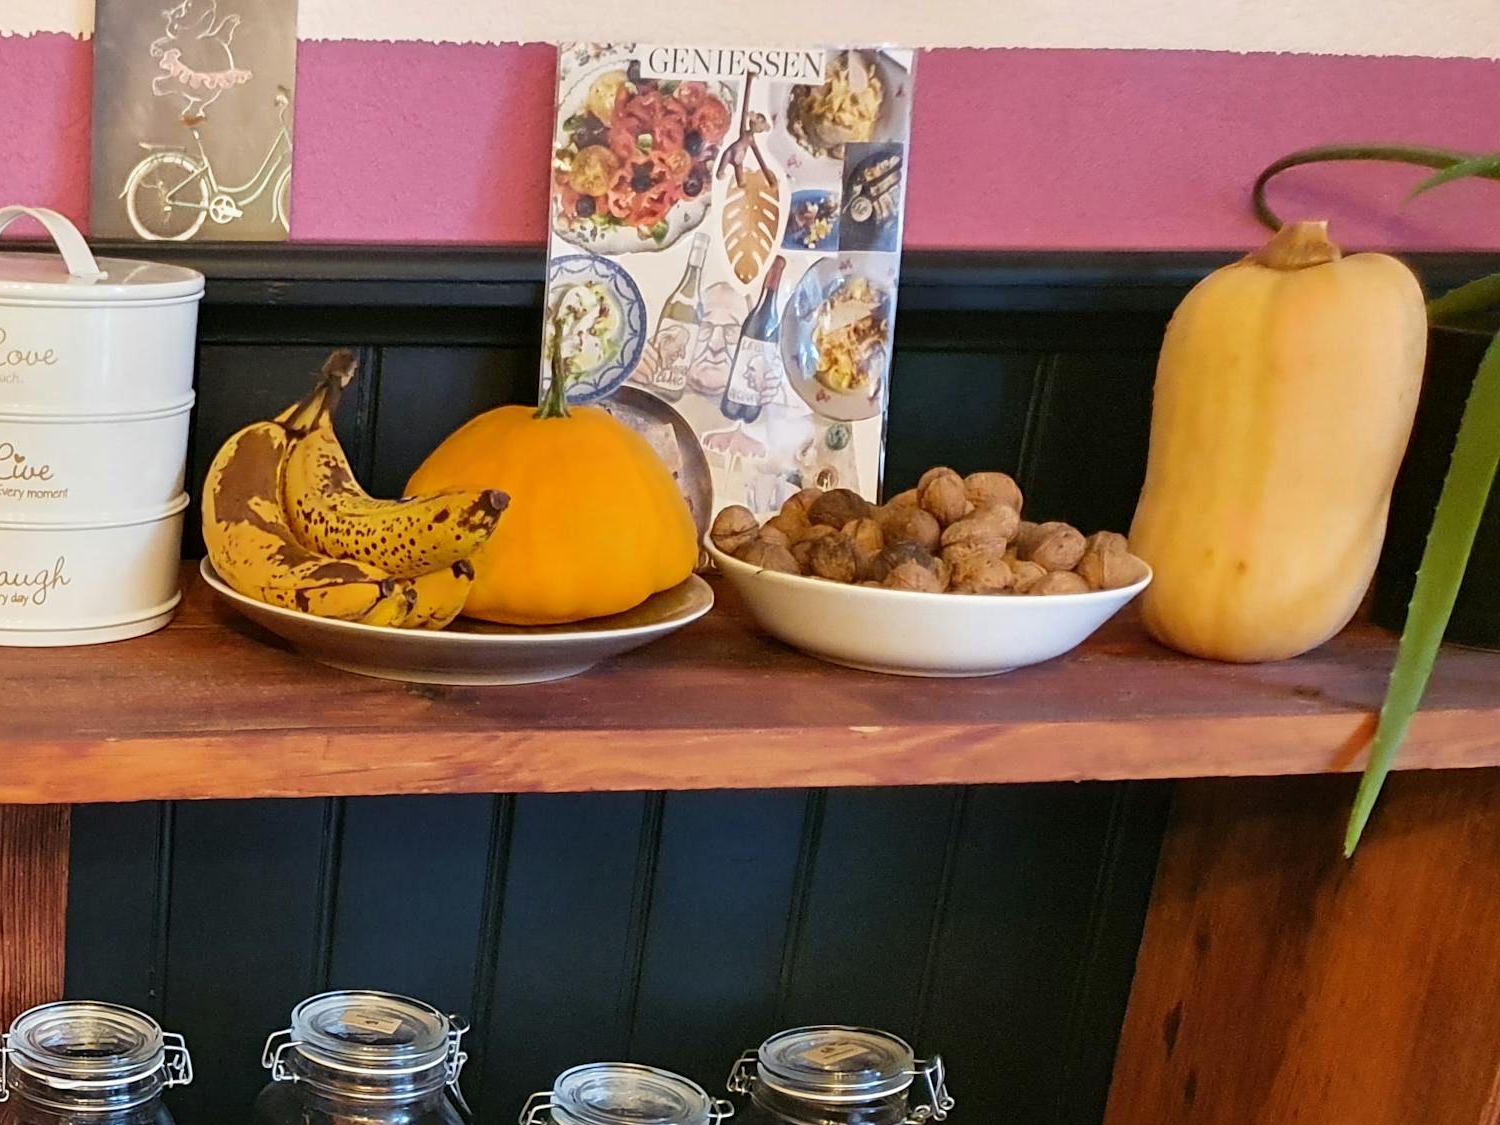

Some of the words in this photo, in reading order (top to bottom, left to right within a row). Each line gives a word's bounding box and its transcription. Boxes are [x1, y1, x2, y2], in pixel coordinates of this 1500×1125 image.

[649, 47, 824, 79] GENIESSEN
[26, 488, 69, 499] moment
[11, 593, 29, 607] day
